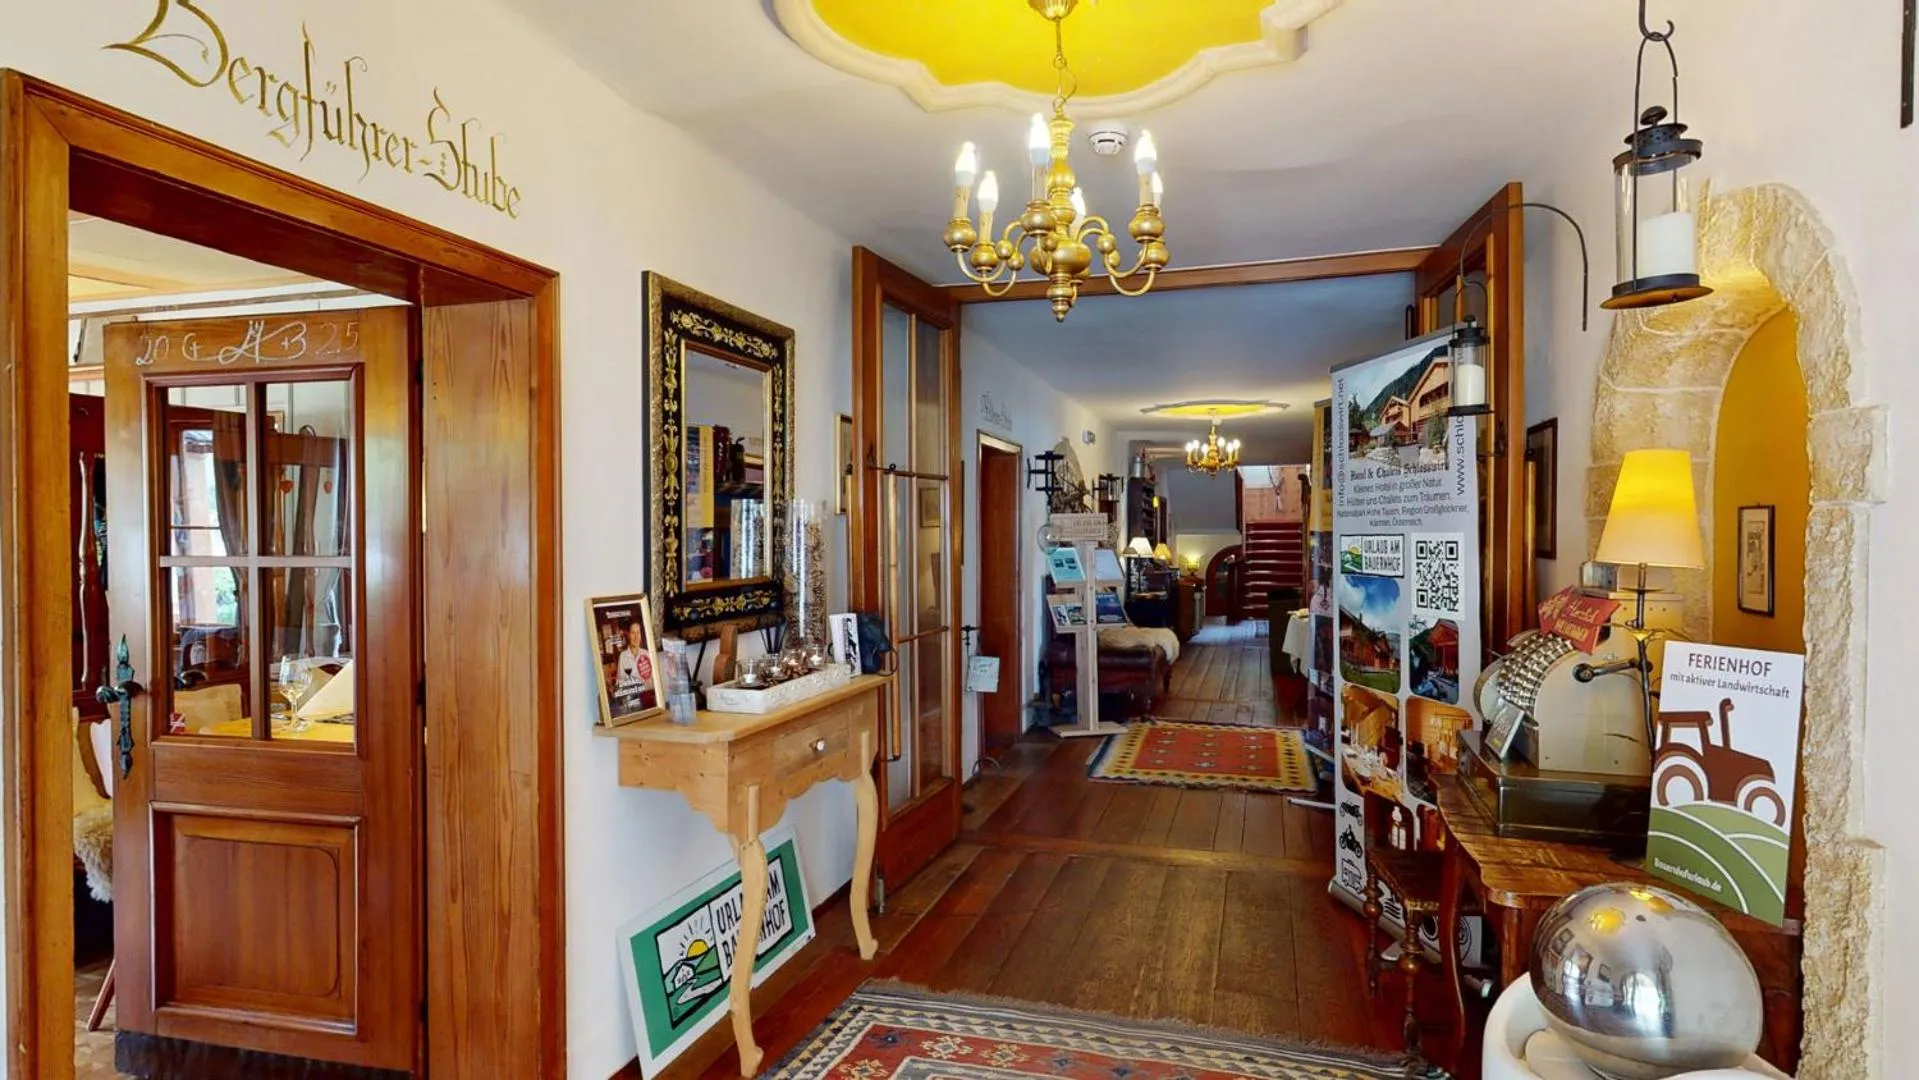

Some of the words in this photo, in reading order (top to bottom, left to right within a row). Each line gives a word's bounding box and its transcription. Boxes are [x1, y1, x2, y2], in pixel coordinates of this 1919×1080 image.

[1688, 652, 1773, 678] FERIENHOF
[1670, 671, 1685, 683] mit
[1686, 673, 1716, 687] aktiver
[1717, 678, 1790, 699] Landwirtschaft
